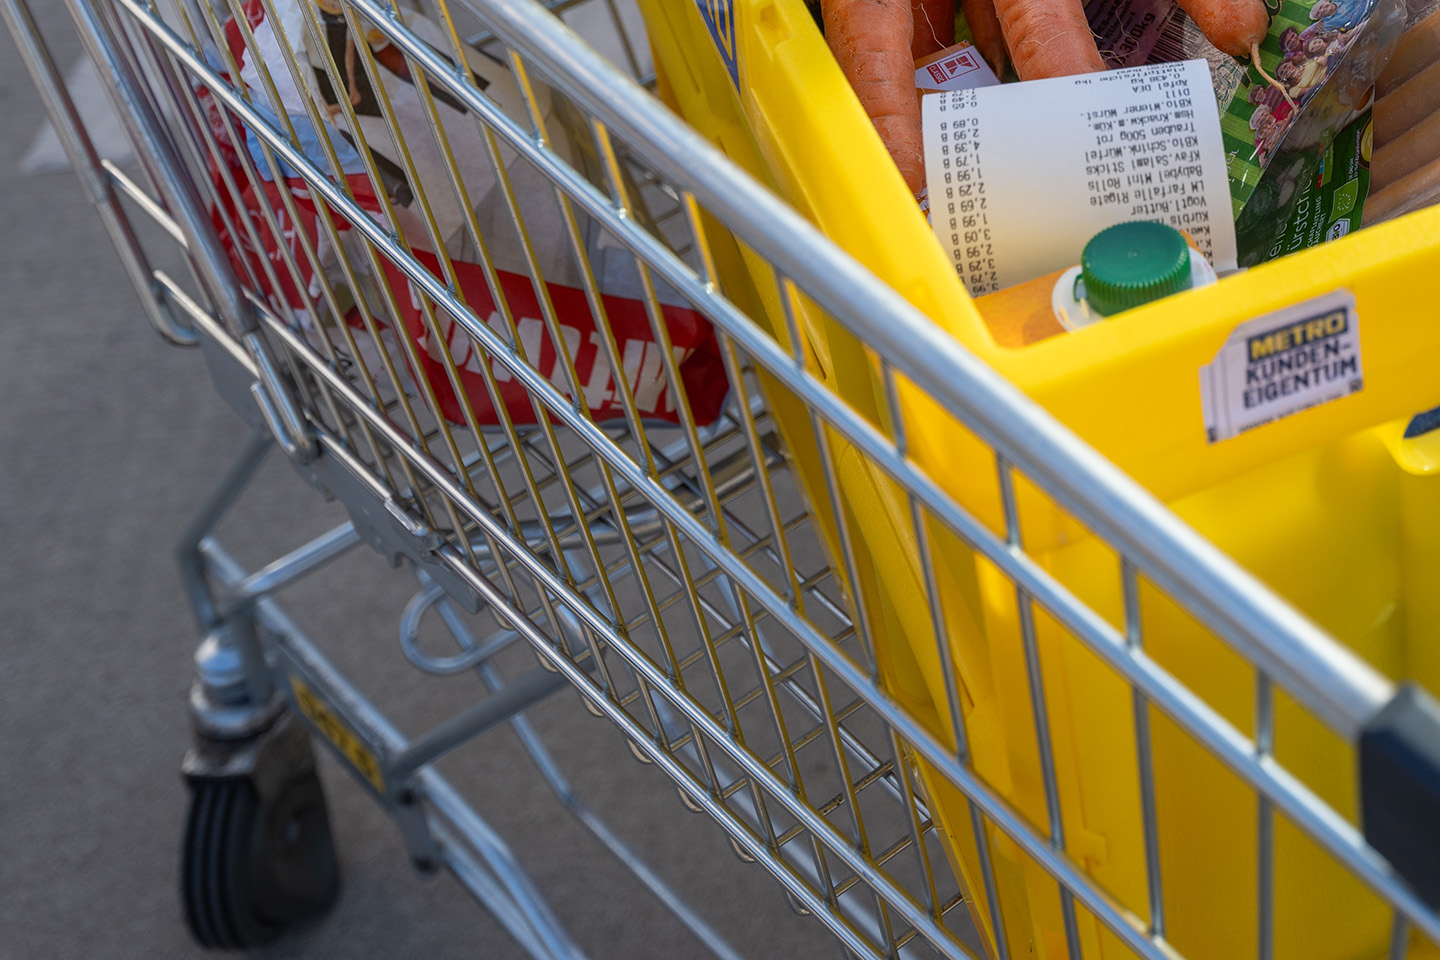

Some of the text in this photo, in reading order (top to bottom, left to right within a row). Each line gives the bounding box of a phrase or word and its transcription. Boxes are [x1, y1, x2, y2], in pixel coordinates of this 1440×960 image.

[927, 63, 946, 84] CLASSIC
[1132, 85, 1152, 93] DEA
[1165, 88, 1190, 99] Dill
[940, 122, 947, 131] B
[941, 98, 1192, 143] KBio.Wiener Würst. 2,99 B
[942, 145, 949, 156] B
[943, 122, 1196, 170] Trauben 500g rot 1,79 B
[954, 140, 981, 154] 4,39
[944, 135, 1199, 184] KBio.Schink.Würfel 1,99 B
[946, 149, 1201, 200] KFav.Salami Sticks 2,29 B
[1126, 172, 1153, 188] Mini
[1158, 165, 1203, 183] Babybel
[1088, 176, 1121, 193] Rolls
[947, 202, 955, 215] B
[949, 180, 1205, 231] LM Farfalle Rigate 1,99 B
[951, 195, 1207, 246] Vogtl.Butter 3,09 B
[1169, 210, 1210, 227] Kürbis
[953, 248, 961, 261] B
[966, 243, 994, 259] 2,99
[968, 258, 996, 273] 3,29
[970, 271, 997, 286] 2,79
[1250, 312, 1345, 360] METRO
[1247, 338, 1353, 384] KUNDEN-
[1244, 356, 1357, 410] EIGENTUM
